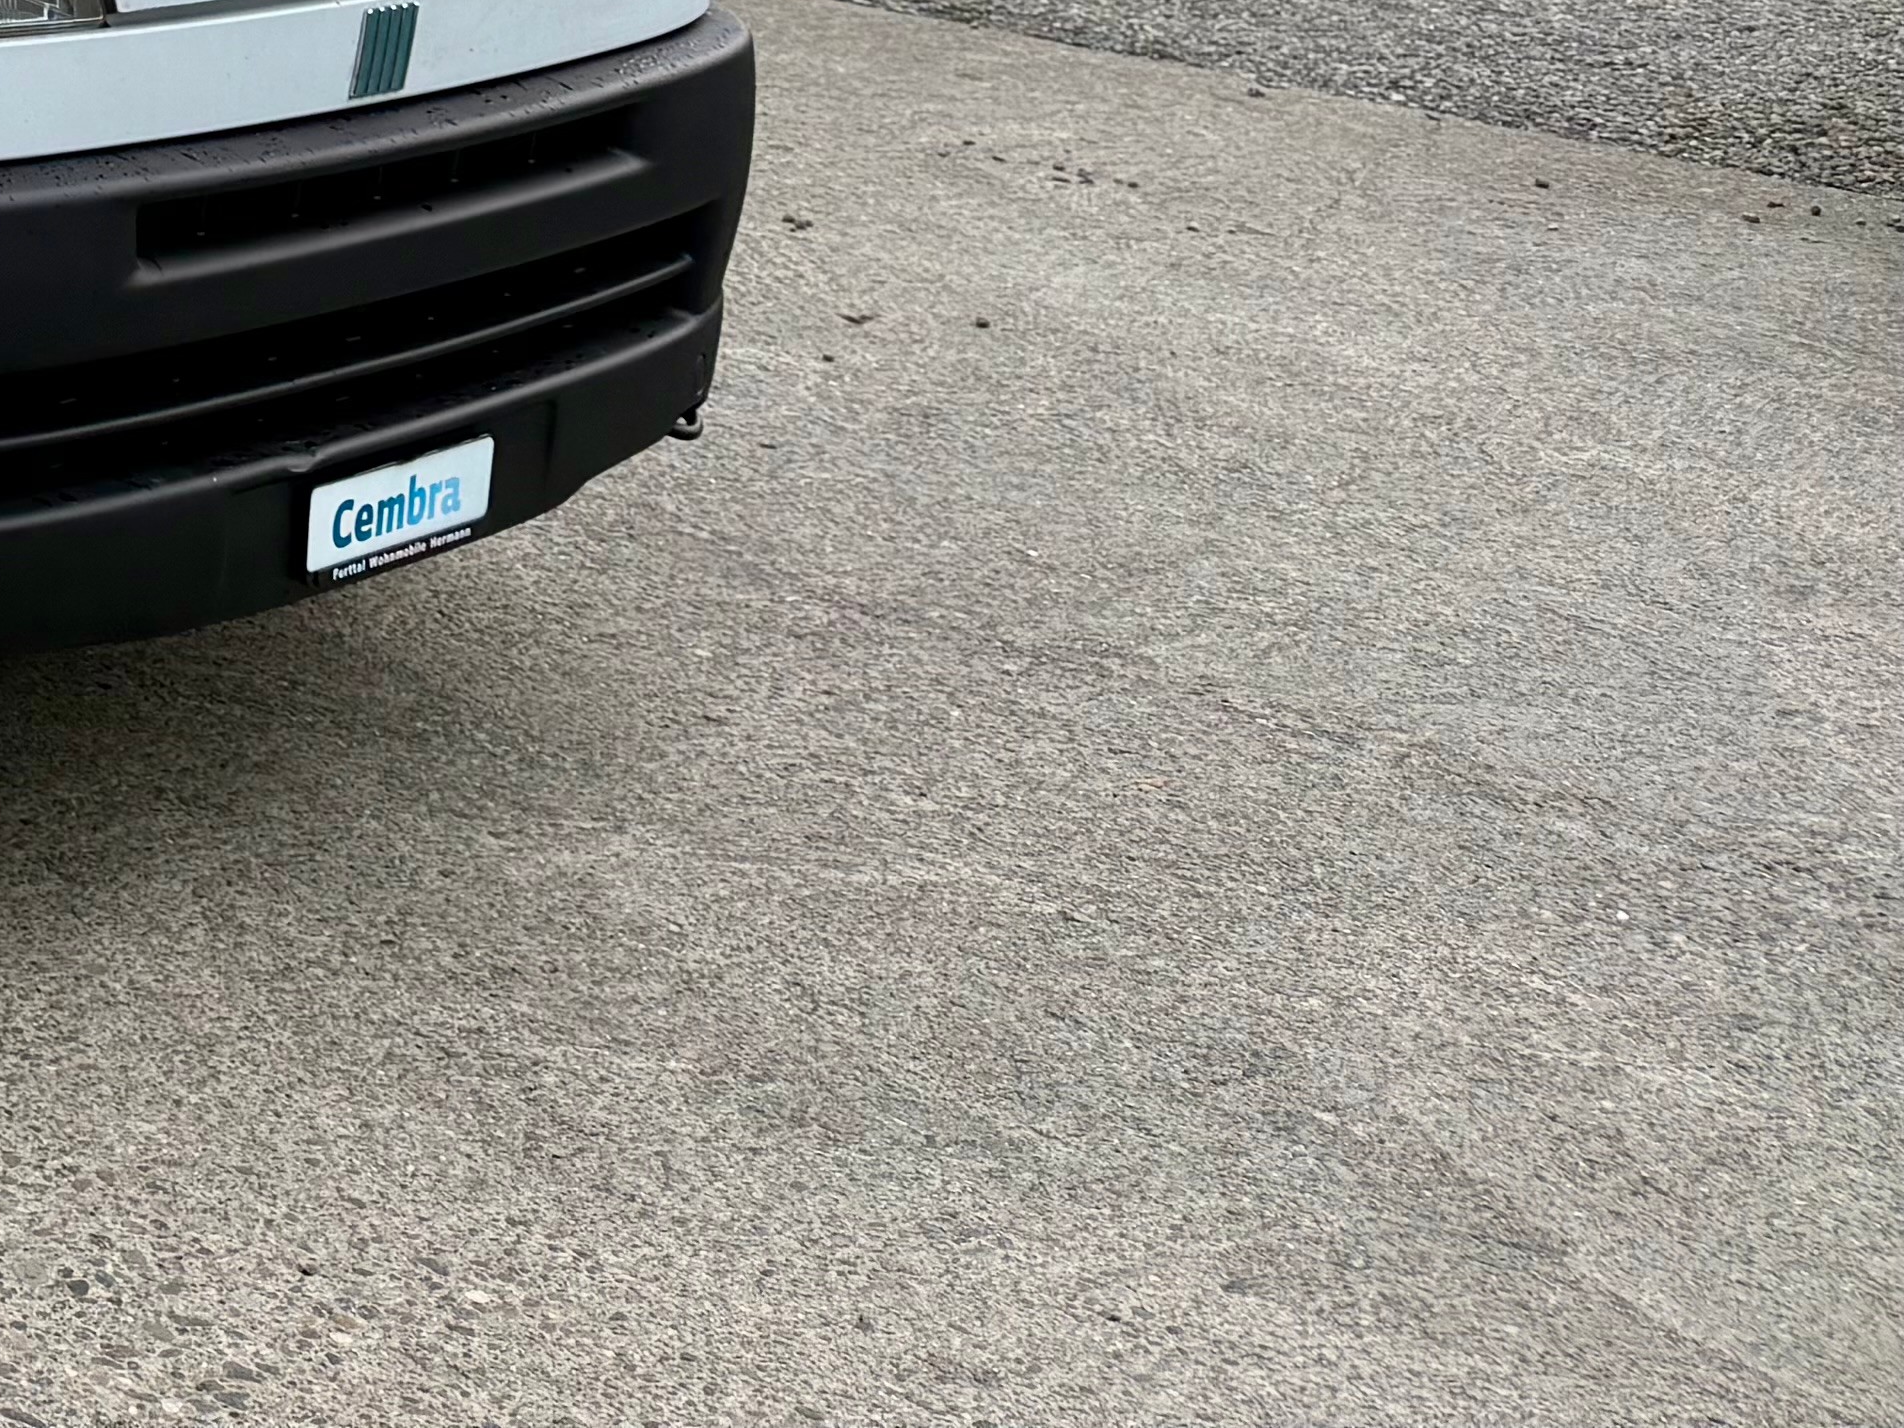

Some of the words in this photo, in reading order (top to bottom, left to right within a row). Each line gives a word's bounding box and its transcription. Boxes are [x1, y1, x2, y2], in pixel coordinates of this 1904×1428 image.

[332, 474, 462, 549] Cembra
[369, 541, 427, 569] Wohnmobile
[430, 527, 472, 549] Hermann
